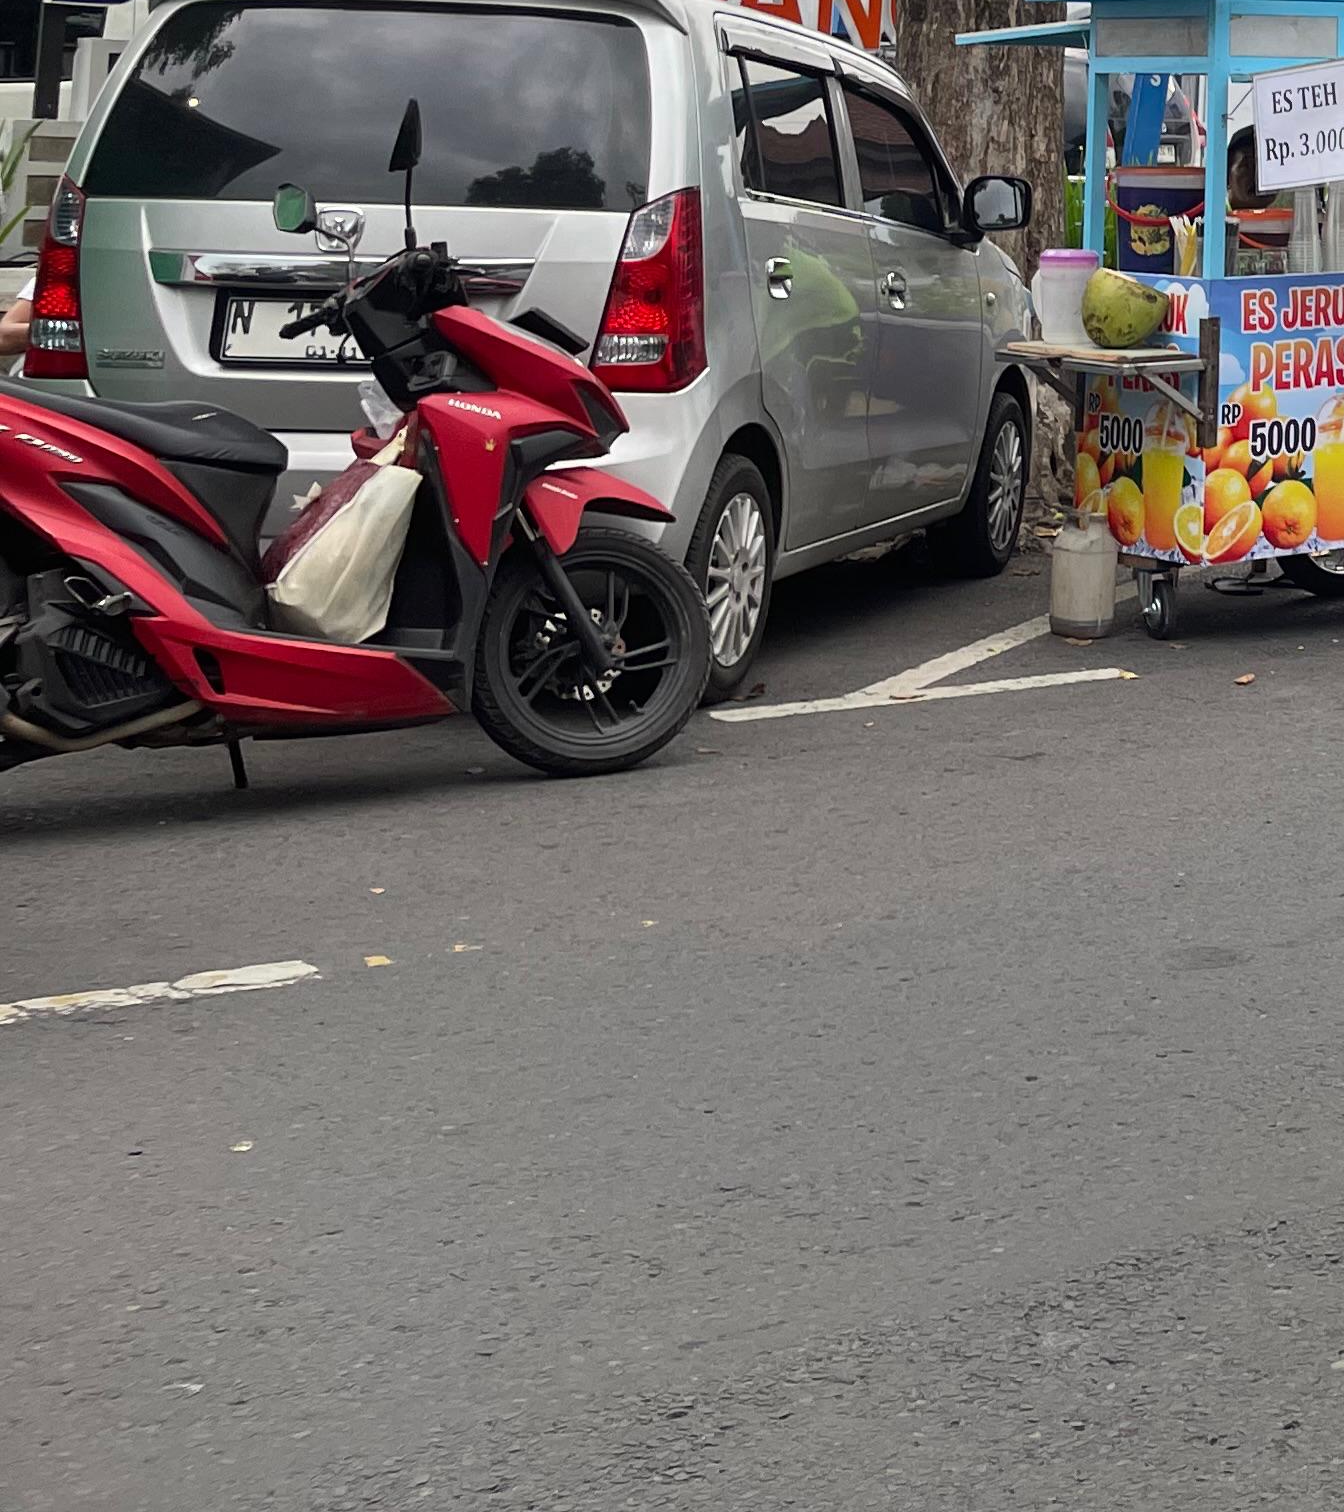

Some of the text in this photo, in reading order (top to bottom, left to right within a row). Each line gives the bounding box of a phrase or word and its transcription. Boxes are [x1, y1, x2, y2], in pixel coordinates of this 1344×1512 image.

[1271, 82, 1338, 115] ES TEH
[1265, 137, 1295, 166] Rp.
[231, 300, 256, 335] N
[1242, 290, 1276, 332] ES
[448, 398, 501, 420] HONDA
[1221, 403, 1242, 426] RP
[1099, 415, 1143, 454] 5000
[1249, 417, 1318, 458] 5000
